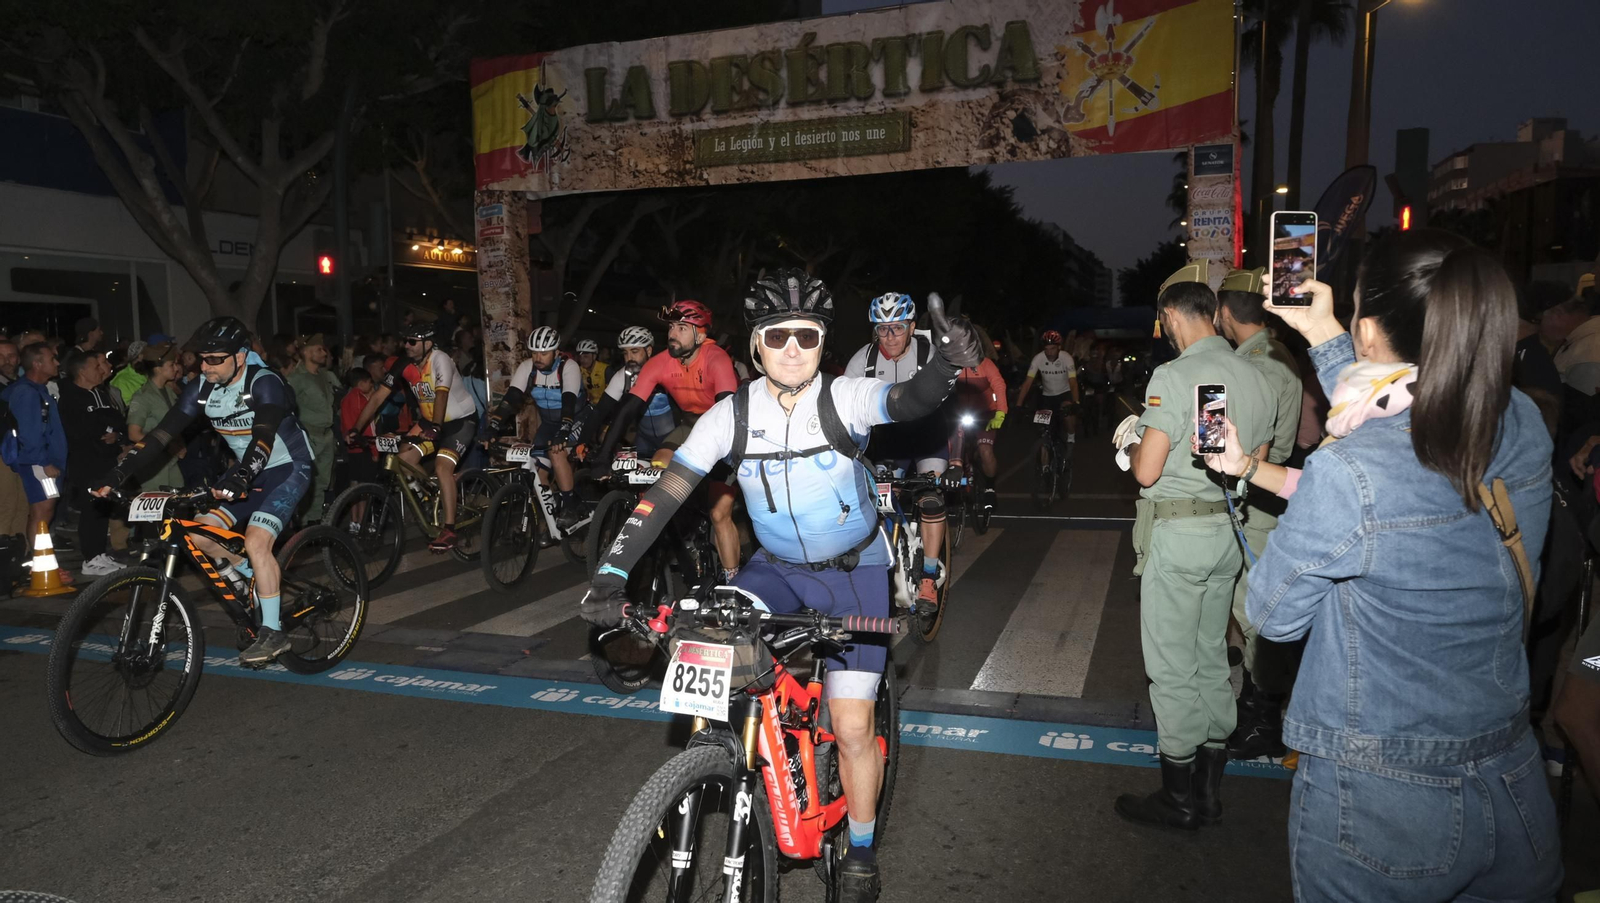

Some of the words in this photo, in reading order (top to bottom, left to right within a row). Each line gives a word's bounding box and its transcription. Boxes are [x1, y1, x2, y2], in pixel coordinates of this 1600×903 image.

[585, 66, 656, 123] LA
[668, 20, 1041, 117] DESÉRTICA
[714, 138, 727, 153] La
[729, 135, 763, 154] Legión
[769, 137, 776, 150] y
[780, 132, 791, 147] el
[795, 130, 836, 146] desierto
[842, 129, 860, 142] nos
[866, 127, 886, 140] une
[1193, 216, 1231, 226] RENTA
[511, 447, 529, 456] 7799
[136, 497, 165, 511] 7000
[185, 535, 237, 601] SCOTT
[373, 675, 498, 693] cajamar
[672, 663, 726, 699] 8255
[684, 701, 715, 712] cajamar
[129, 719, 168, 745] SCORPION
[936, 735, 979, 743] RURAL
